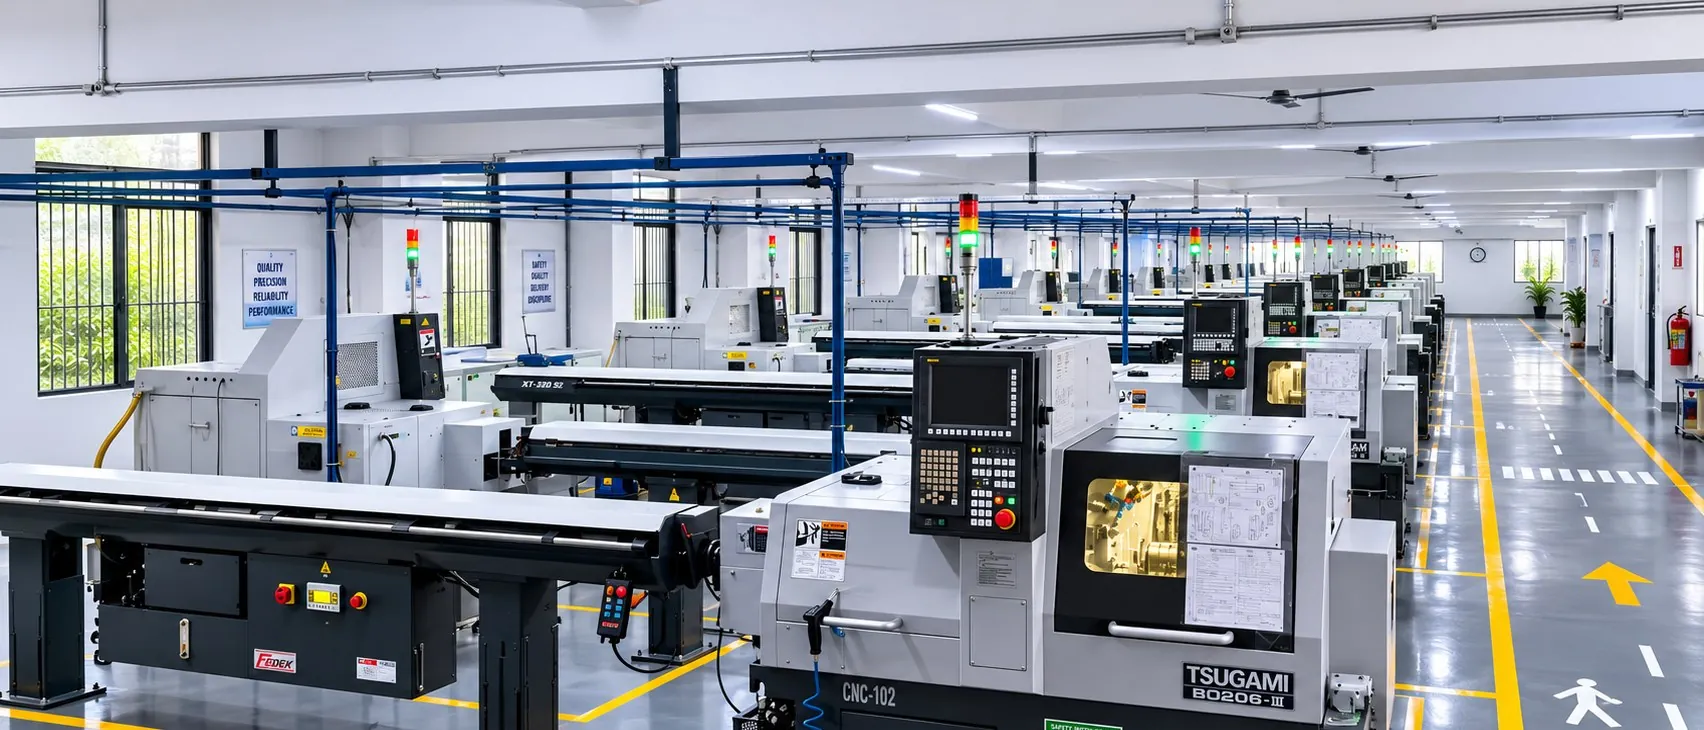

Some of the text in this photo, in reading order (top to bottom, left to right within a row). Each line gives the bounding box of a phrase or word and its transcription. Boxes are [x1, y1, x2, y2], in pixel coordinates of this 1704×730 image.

[257, 262, 284, 272] QUALITY
[254, 277, 286, 286] PRECISION
[254, 292, 288, 302] RELIABILITY
[248, 306, 294, 316] PERFORMANCE
[1186, 666, 1288, 692] TSUGAMI
[843, 682, 896, 706] CNC-102
